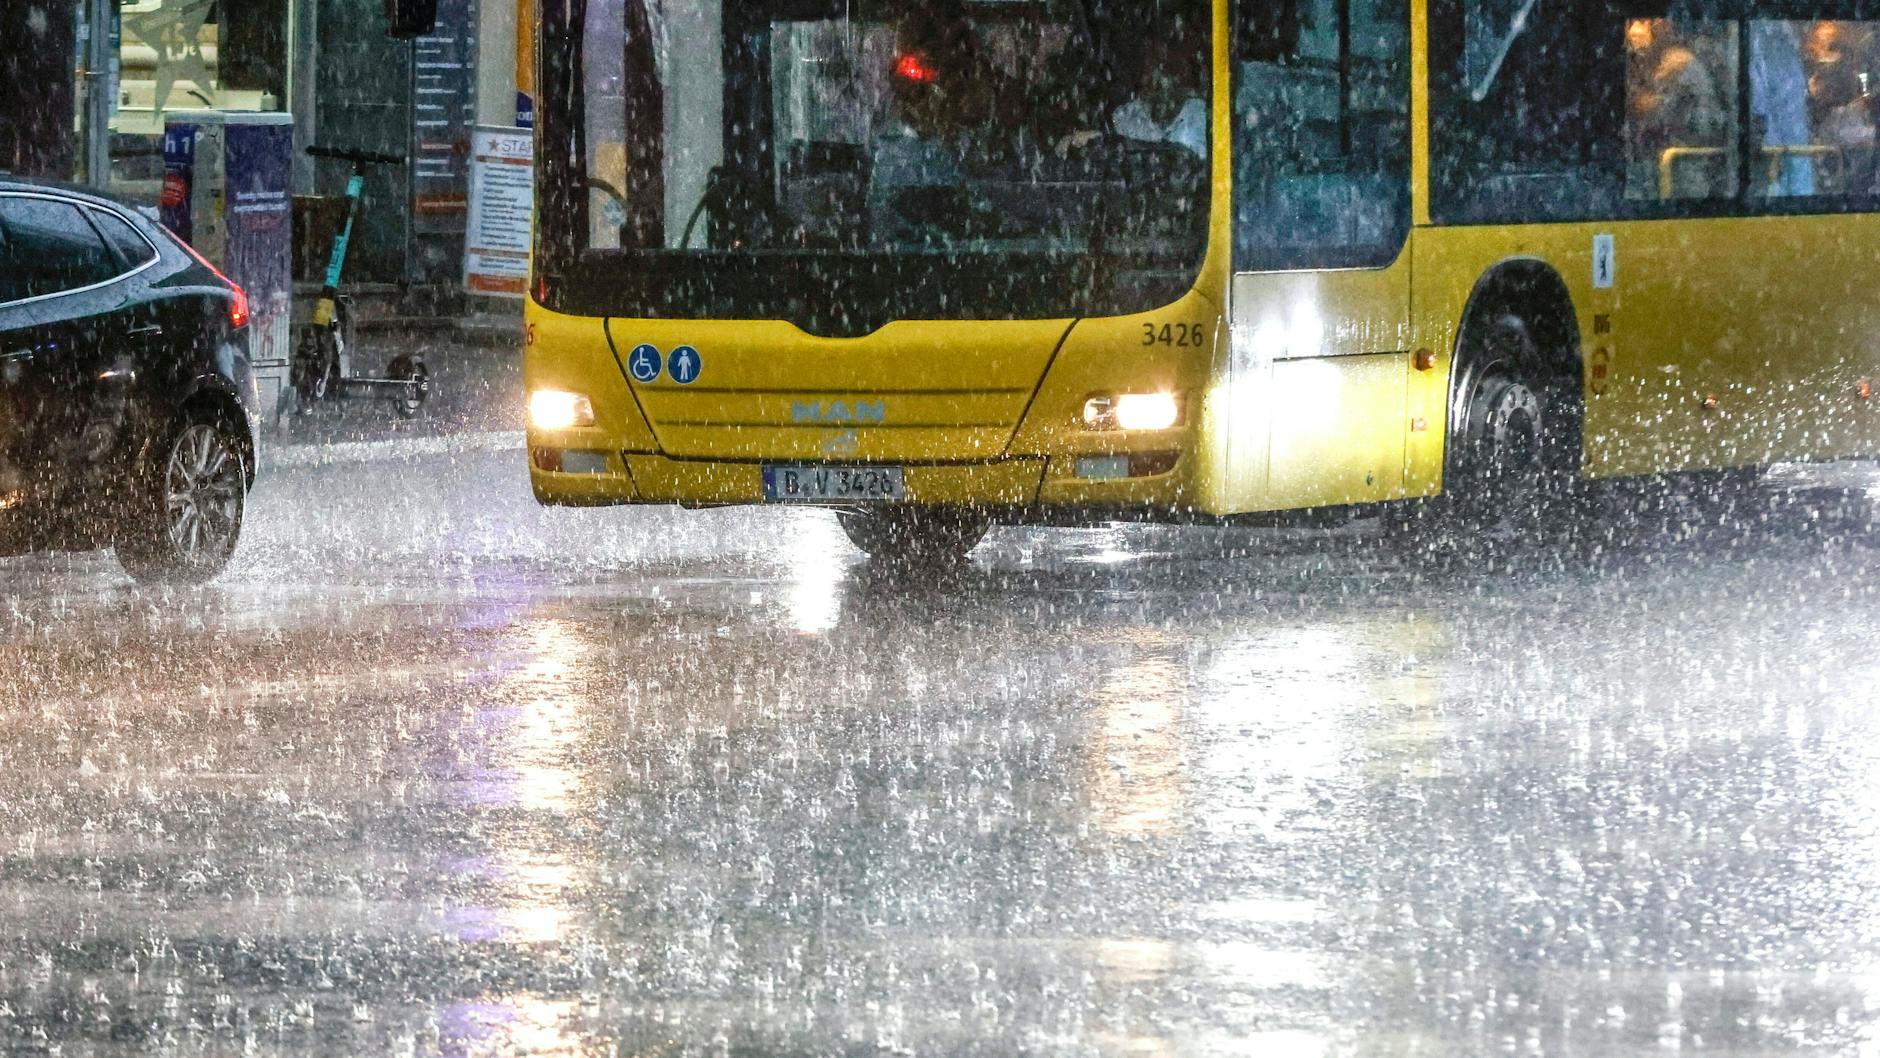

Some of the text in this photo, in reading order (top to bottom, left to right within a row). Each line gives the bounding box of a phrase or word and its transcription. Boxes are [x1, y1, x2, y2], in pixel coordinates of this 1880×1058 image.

[1142, 322, 1203, 347] 3426
[792, 400, 885, 422] MAN
[785, 470, 894, 496] B V 3426
